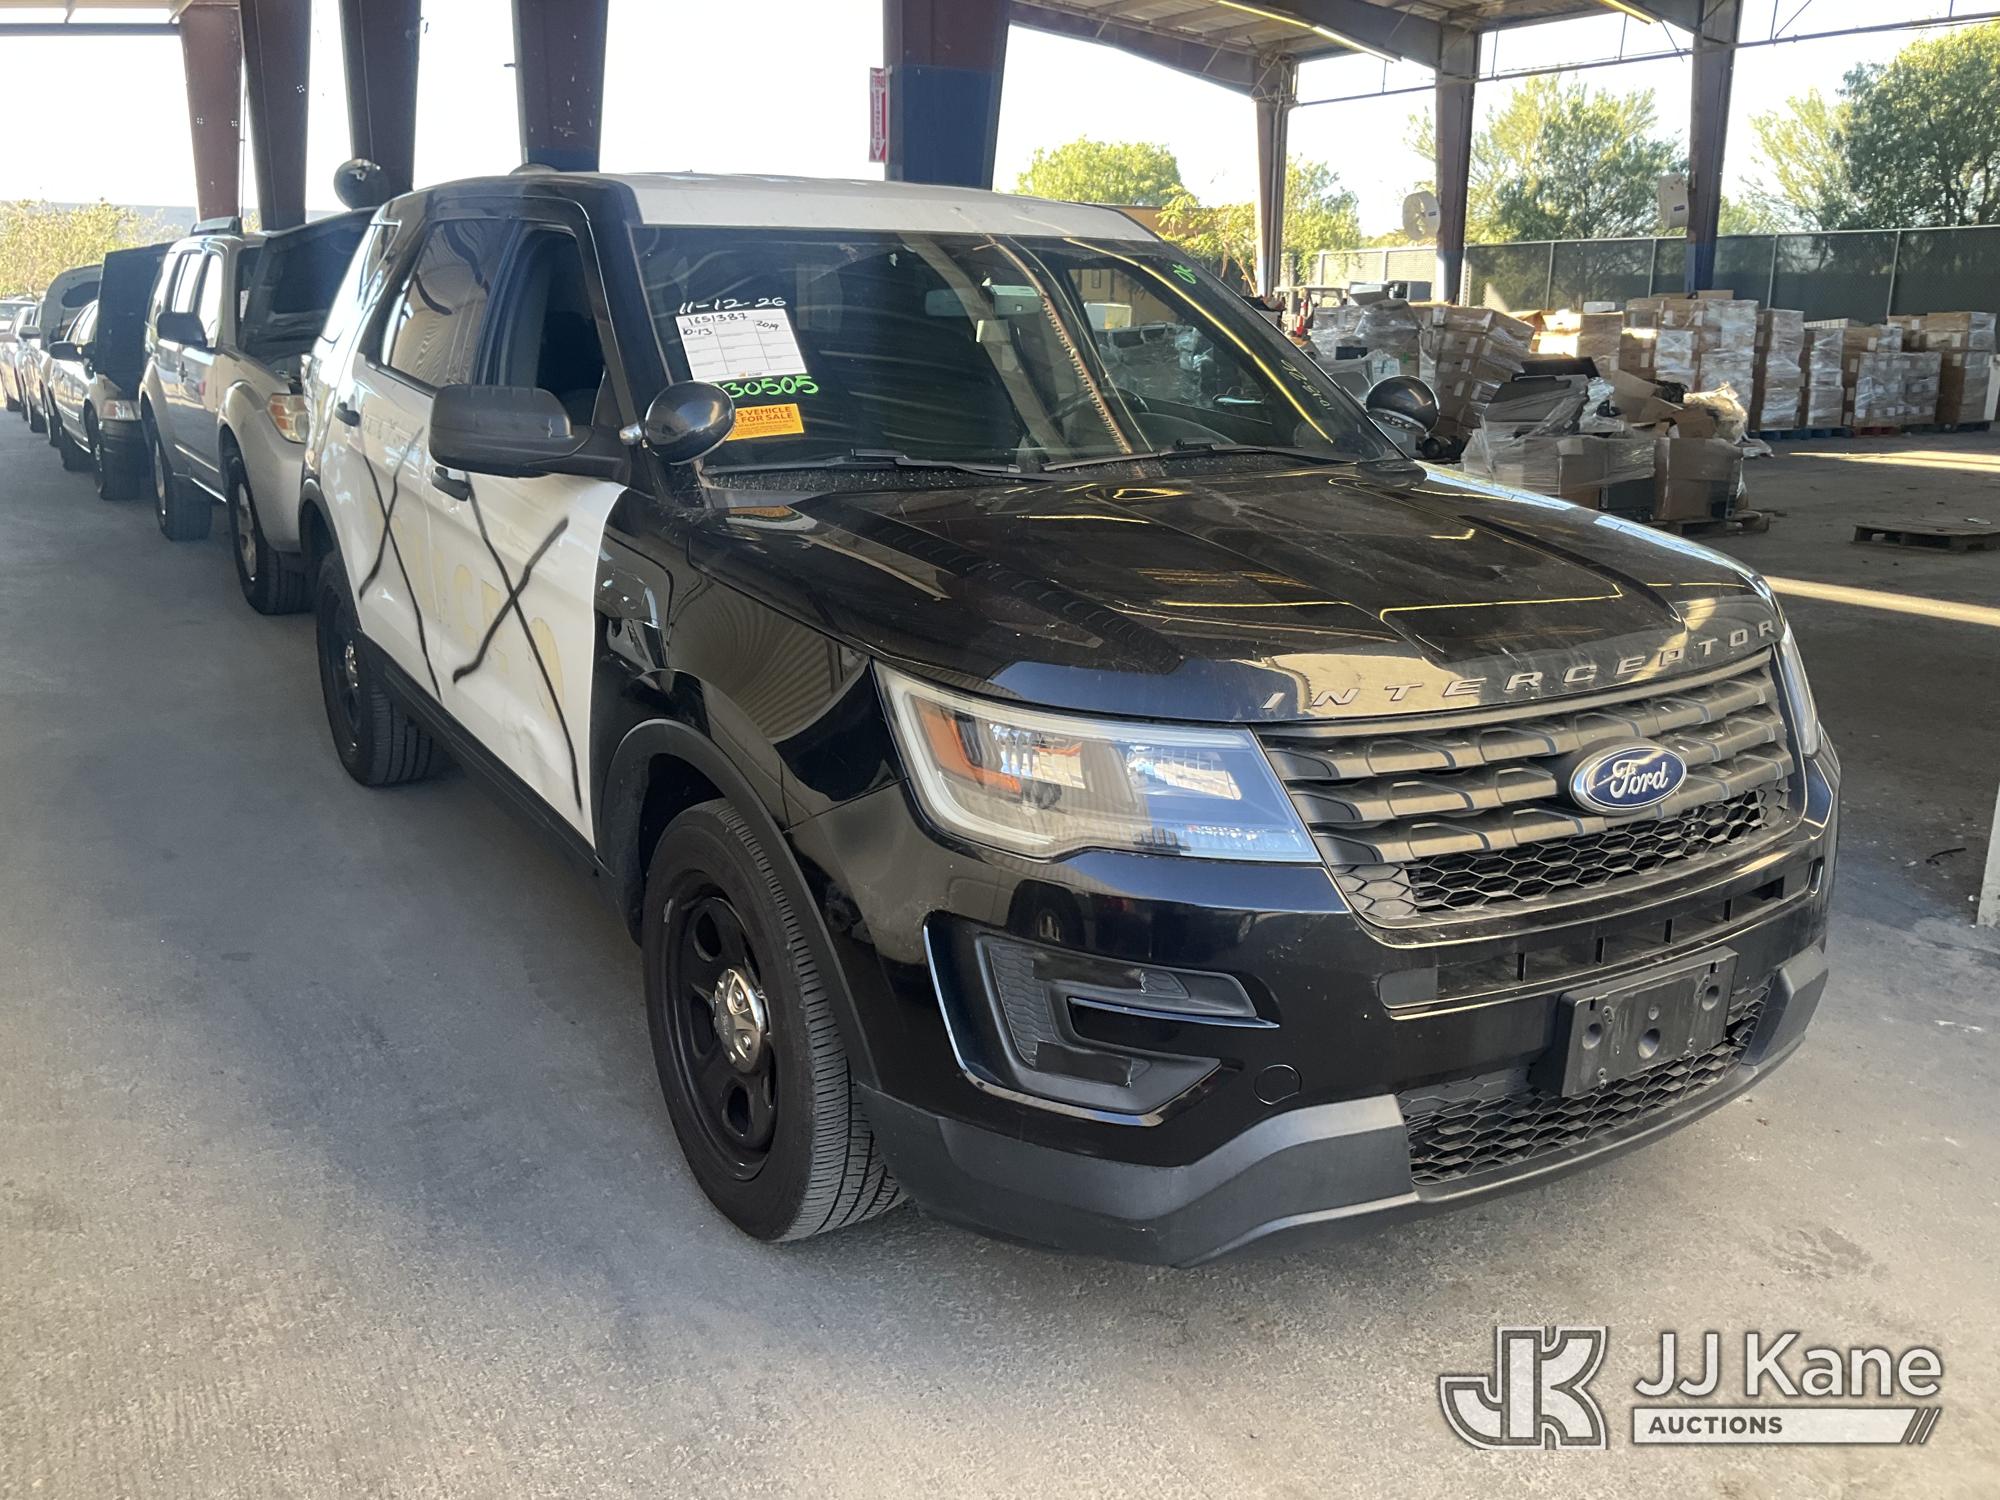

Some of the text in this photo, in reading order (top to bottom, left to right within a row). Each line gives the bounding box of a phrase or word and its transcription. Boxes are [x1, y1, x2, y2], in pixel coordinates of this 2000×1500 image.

[741, 415, 765, 423] FOR
[765, 412, 794, 421] SALE
[745, 405, 792, 417] VEHICLE
[1260, 618, 1776, 711] INTERCEPTOR
[1609, 757, 1670, 800] Ford
